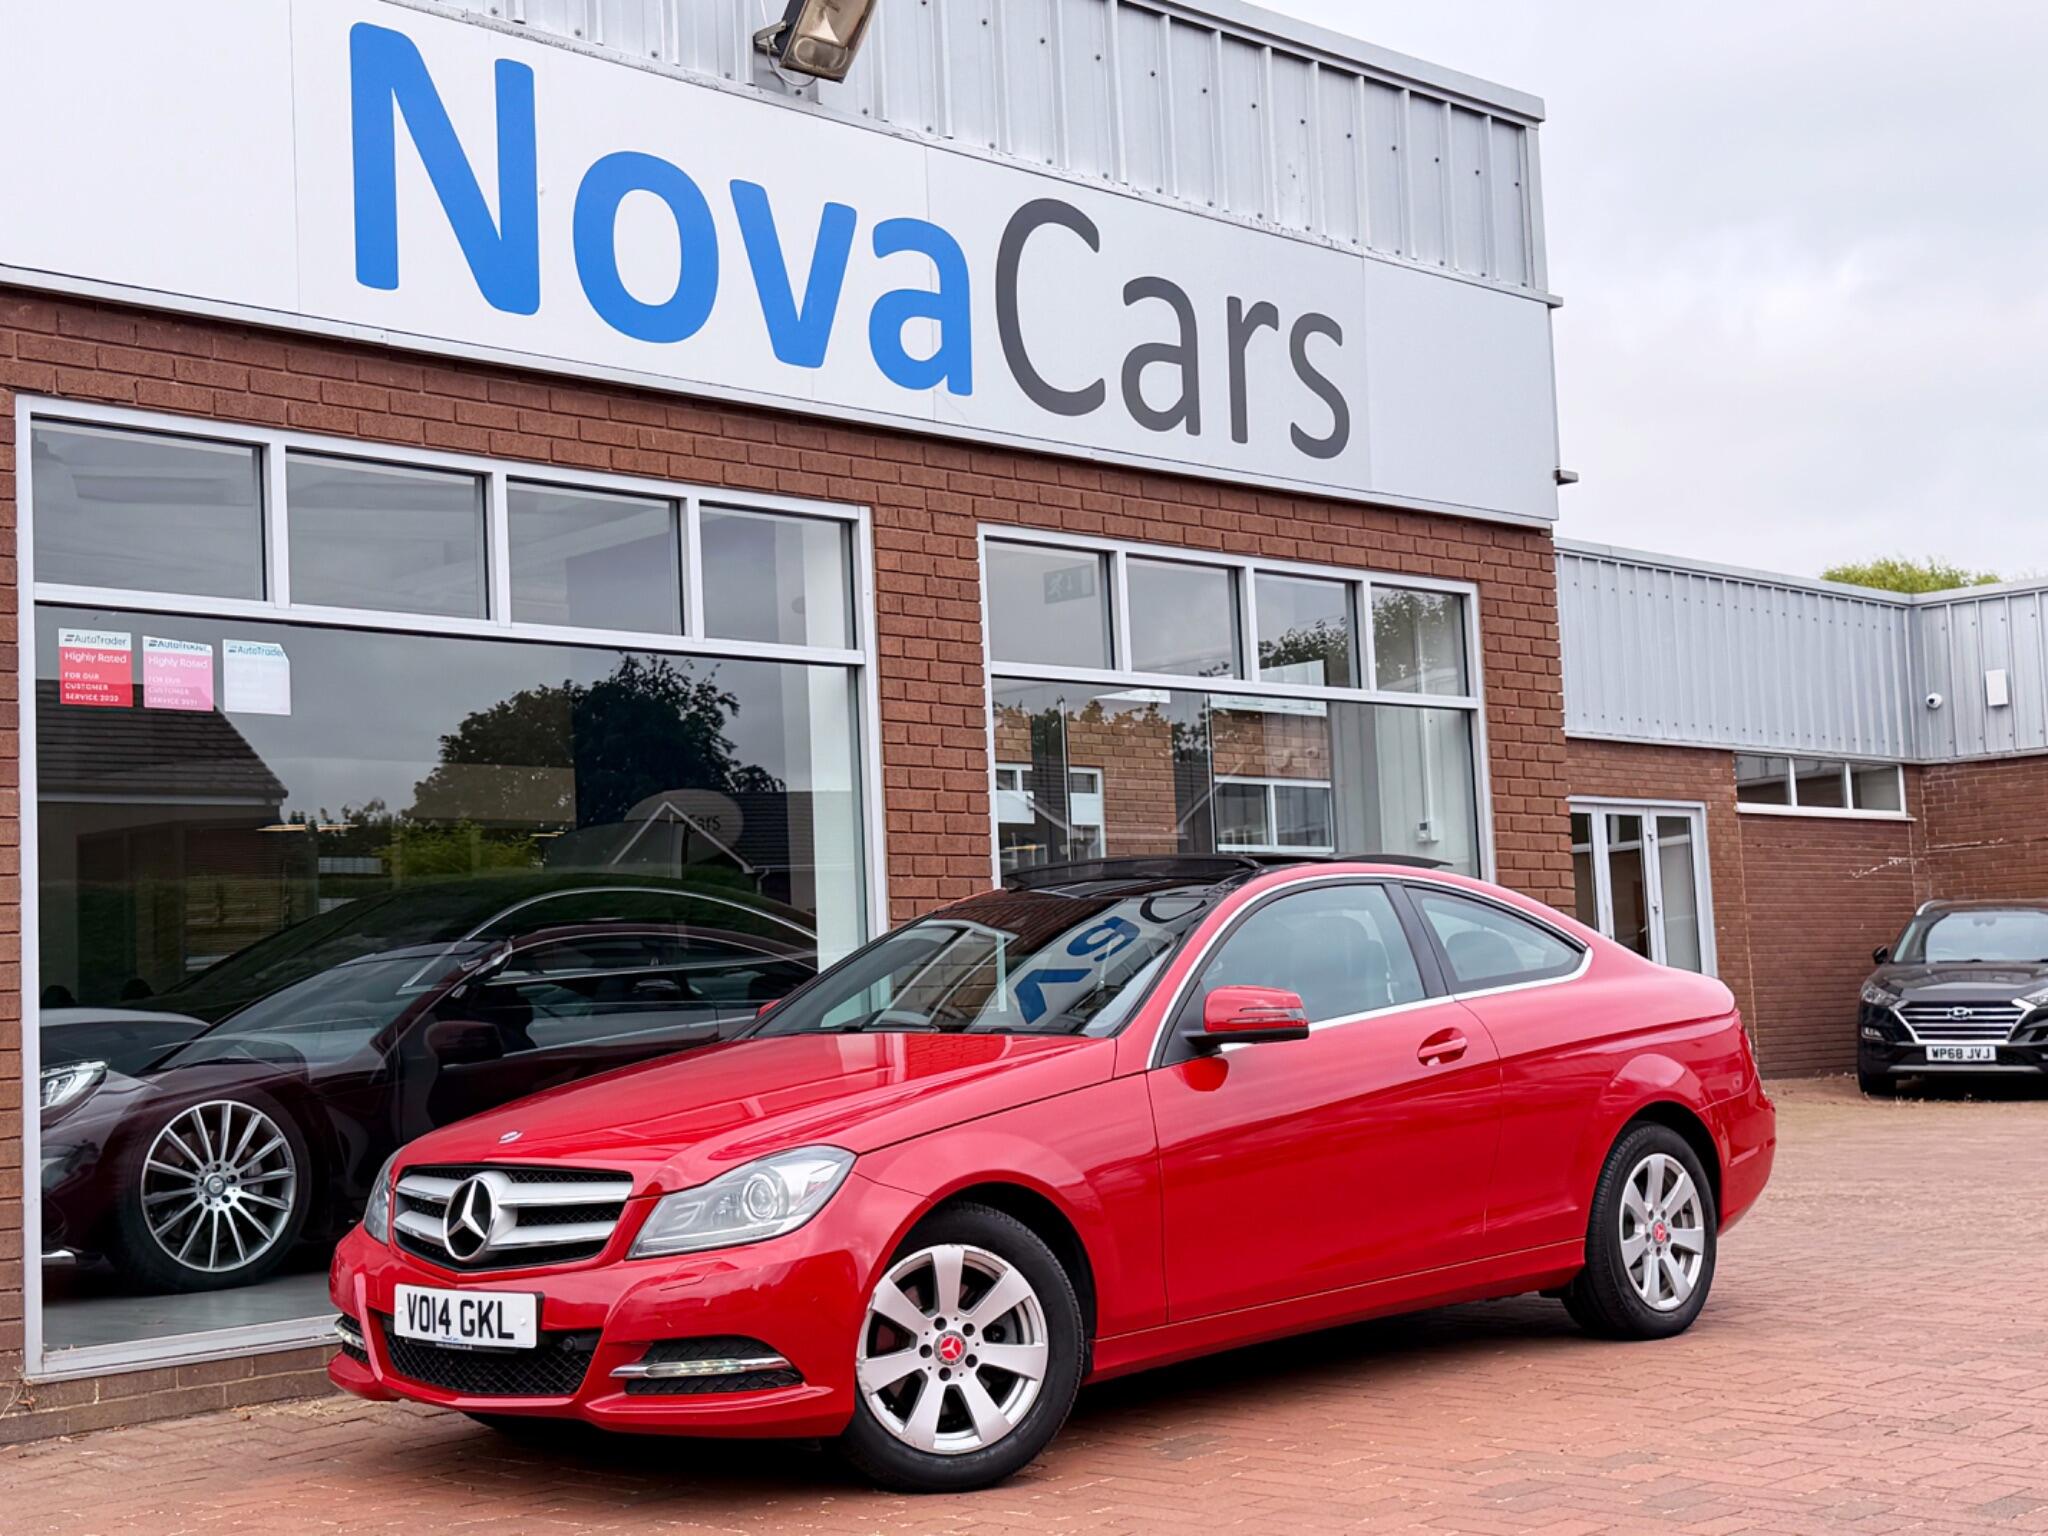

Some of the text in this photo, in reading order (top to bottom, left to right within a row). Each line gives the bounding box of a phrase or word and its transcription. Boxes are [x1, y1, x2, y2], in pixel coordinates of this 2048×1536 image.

[350, 23, 1350, 459] NovaCars
[65, 651, 127, 664] Highly Rated
[148, 656, 178, 668] Highly
[82, 672, 100, 680] OUR
[65, 682, 109, 691] CUSTOMER
[65, 692, 98, 701] SERVICE
[1932, 1047, 1991, 1059] WP68 JVJ
[406, 1292, 515, 1340] VO14 GKL
